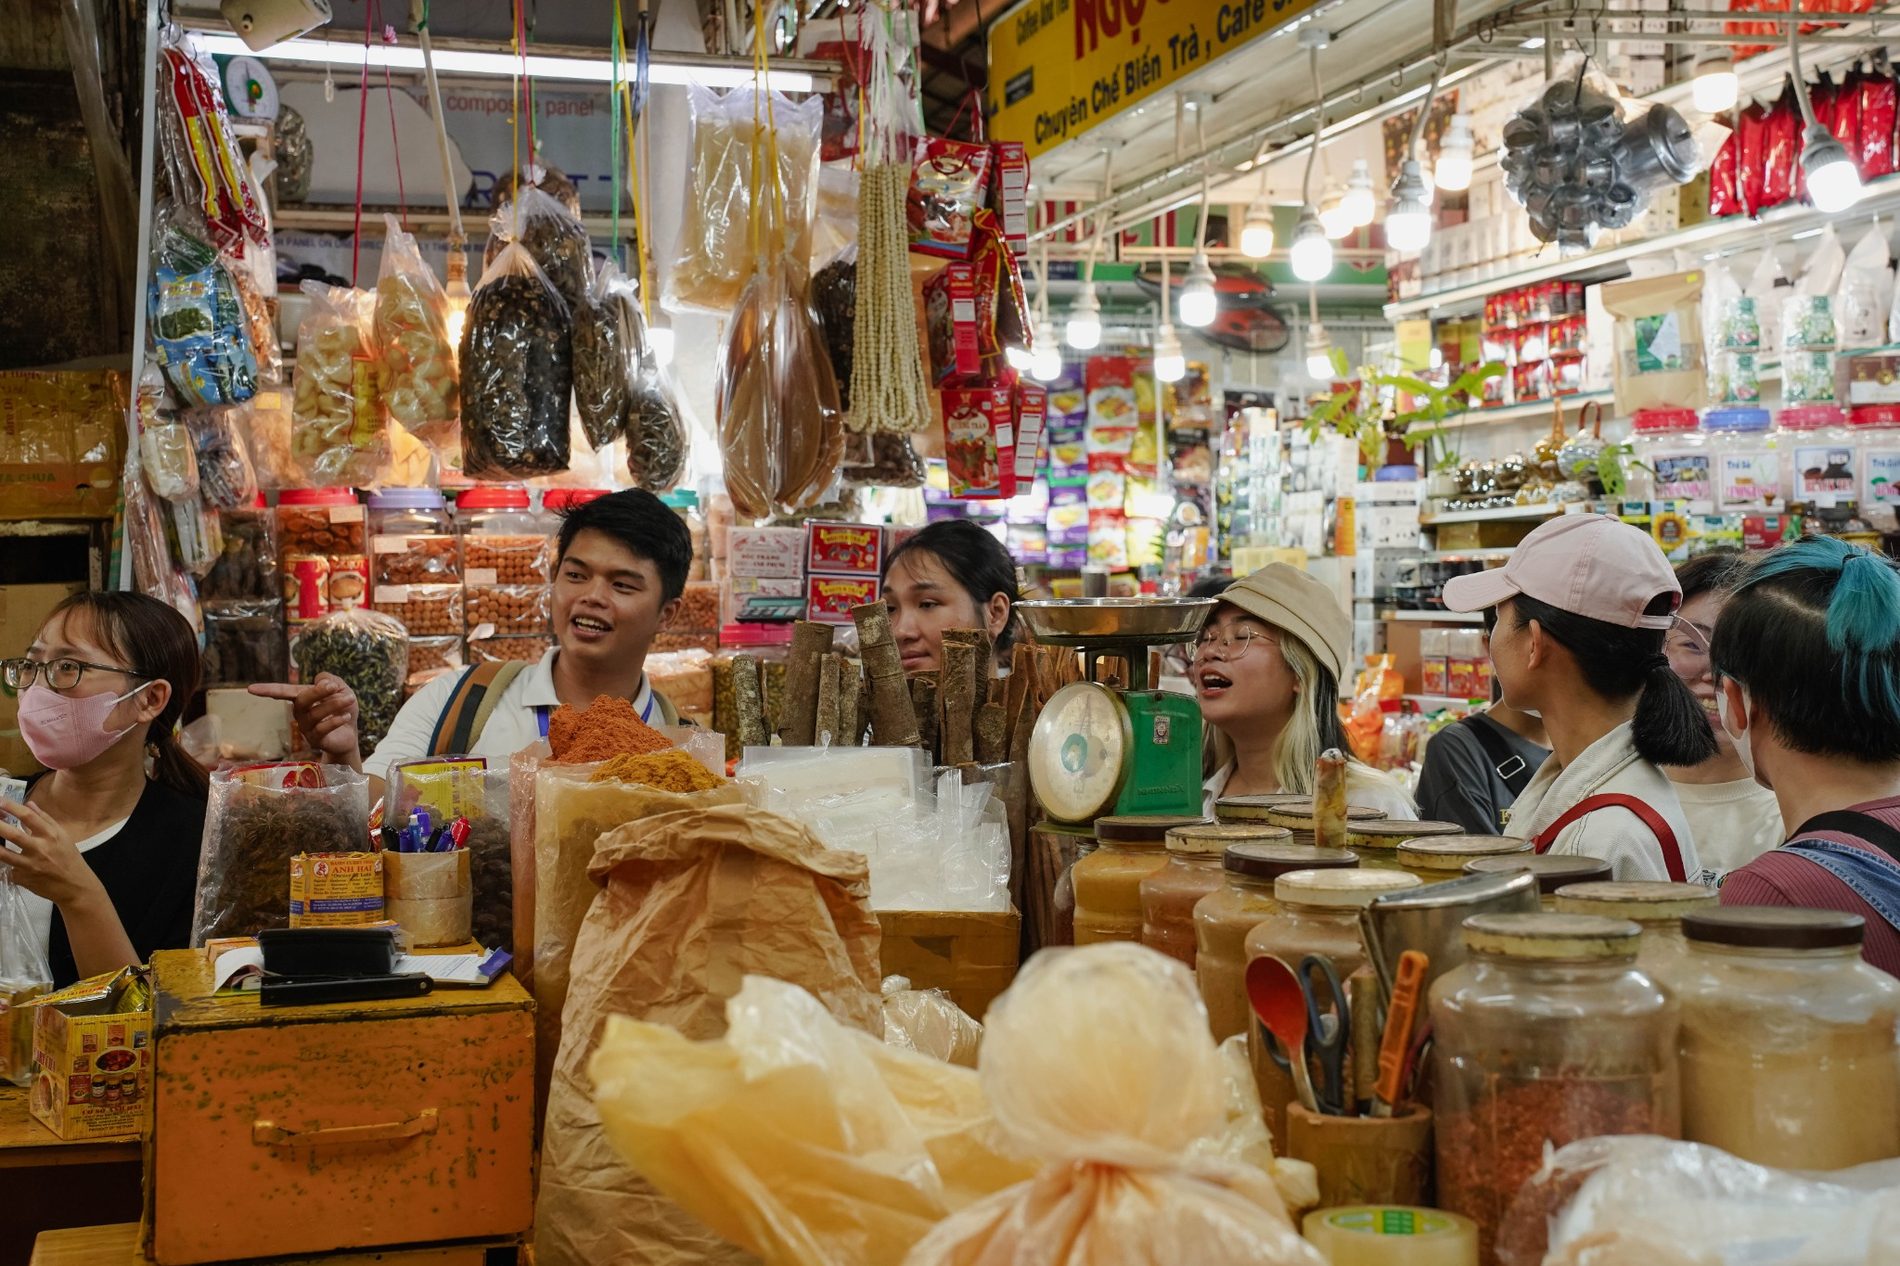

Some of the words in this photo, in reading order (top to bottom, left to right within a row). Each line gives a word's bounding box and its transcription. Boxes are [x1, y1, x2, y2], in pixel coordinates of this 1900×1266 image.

[1075, 0, 1173, 60] NGỌ
[1035, 95, 1088, 145] Chuyên
[1091, 63, 1120, 115] Chế
[1124, 44, 1162, 96] Biến
[1168, 23, 1199, 71] Trà
[546, 99, 594, 117] panel
[287, 236, 315, 248] PANEL
